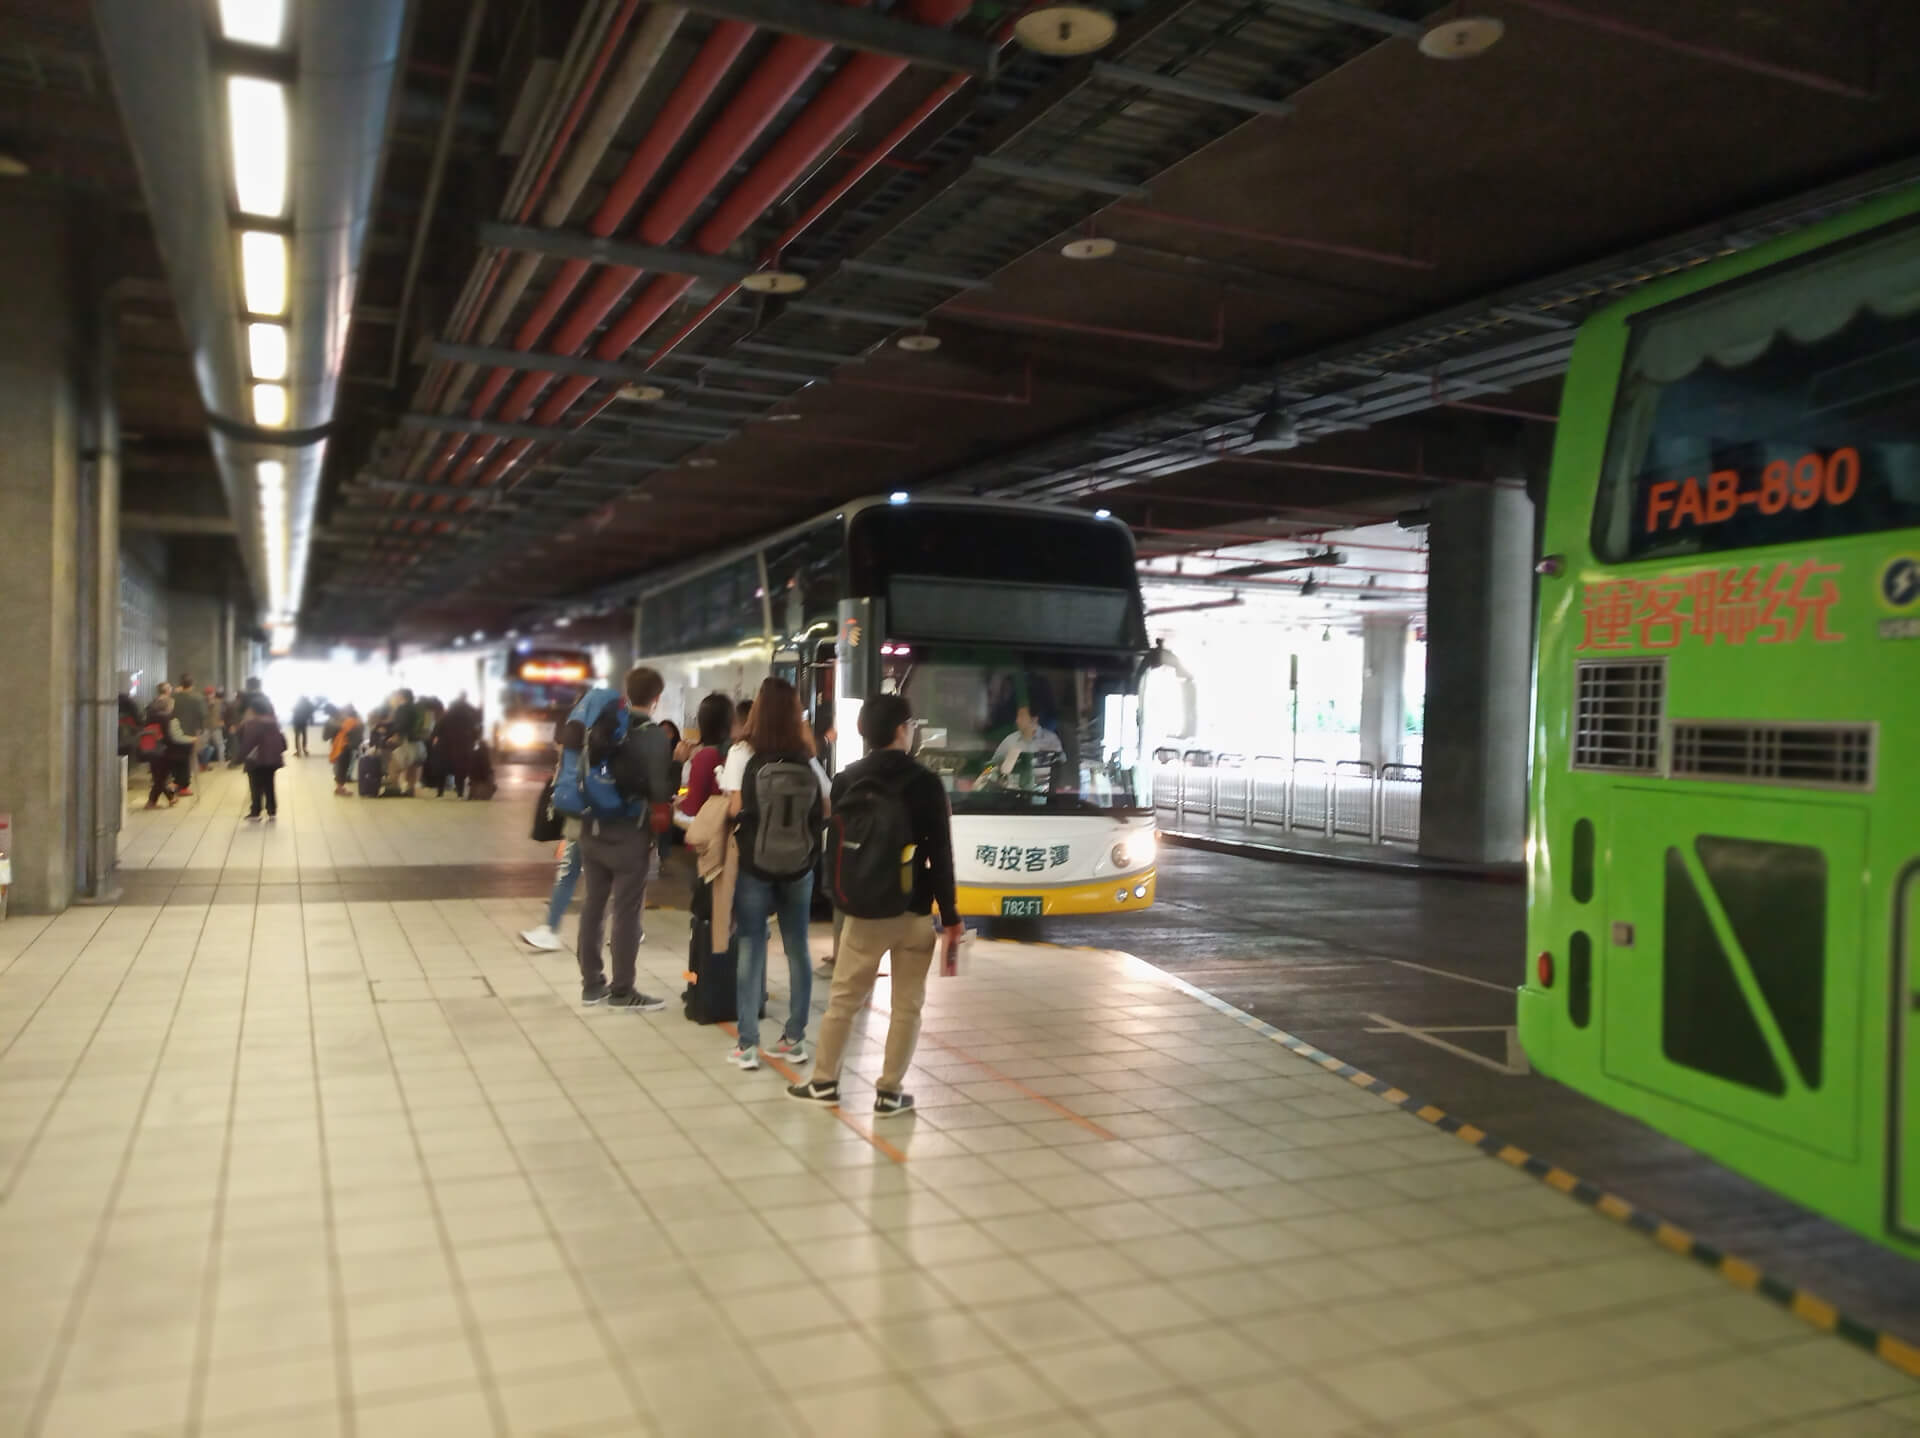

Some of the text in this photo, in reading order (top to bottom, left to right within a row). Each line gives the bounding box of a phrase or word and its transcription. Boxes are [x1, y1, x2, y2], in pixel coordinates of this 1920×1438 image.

[1646, 447, 1860, 533] FAB-890
[976, 844, 1070, 872] 南投客運
